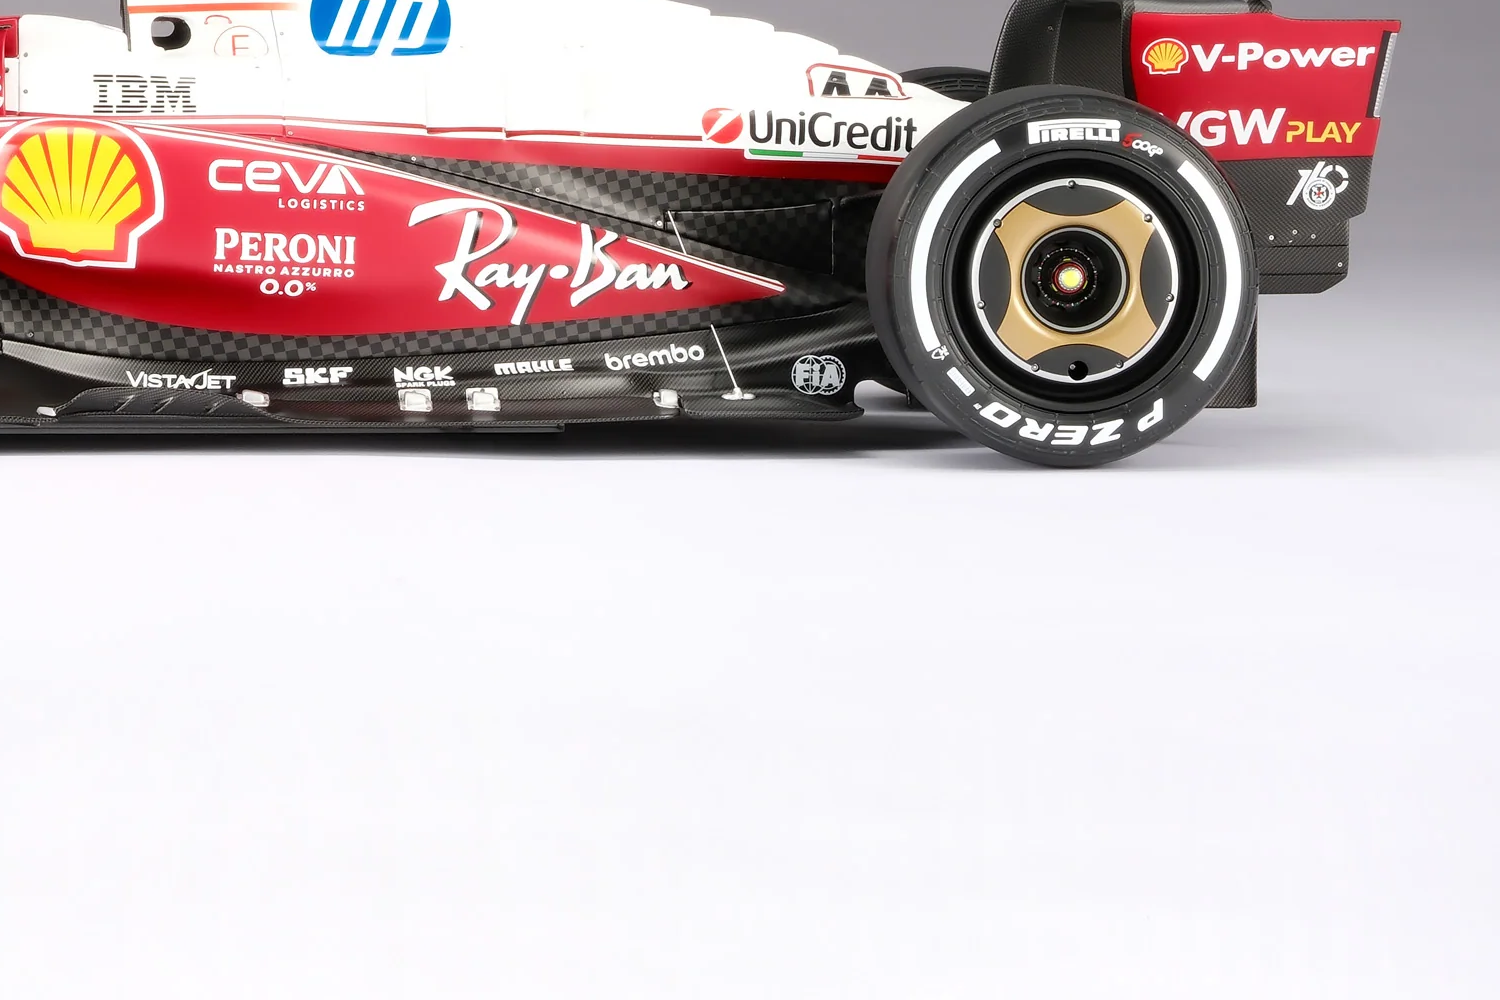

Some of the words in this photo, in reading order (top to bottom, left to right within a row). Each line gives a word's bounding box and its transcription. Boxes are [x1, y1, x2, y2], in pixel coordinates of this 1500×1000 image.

[1191, 42, 1376, 73] V-Power
[92, 74, 197, 114] IBM
[748, 110, 918, 153] UniCredit
[1027, 118, 1122, 145] PIRELLI
[1285, 120, 1362, 144] PLAY
[278, 198, 366, 212] LOGISTICS
[213, 227, 357, 265] PERONI
[213, 263, 277, 276] NASTRO
[279, 266, 355, 279] AZZURRO
[259, 278, 317, 298] 0.0%
[493, 357, 576, 376] MAHLE
[603, 344, 706, 371] brembo
[282, 366, 354, 386] SKF
[393, 365, 454, 382] NGK
[979, 401, 1125, 446] ZERO
[1136, 397, 1165, 433] P
